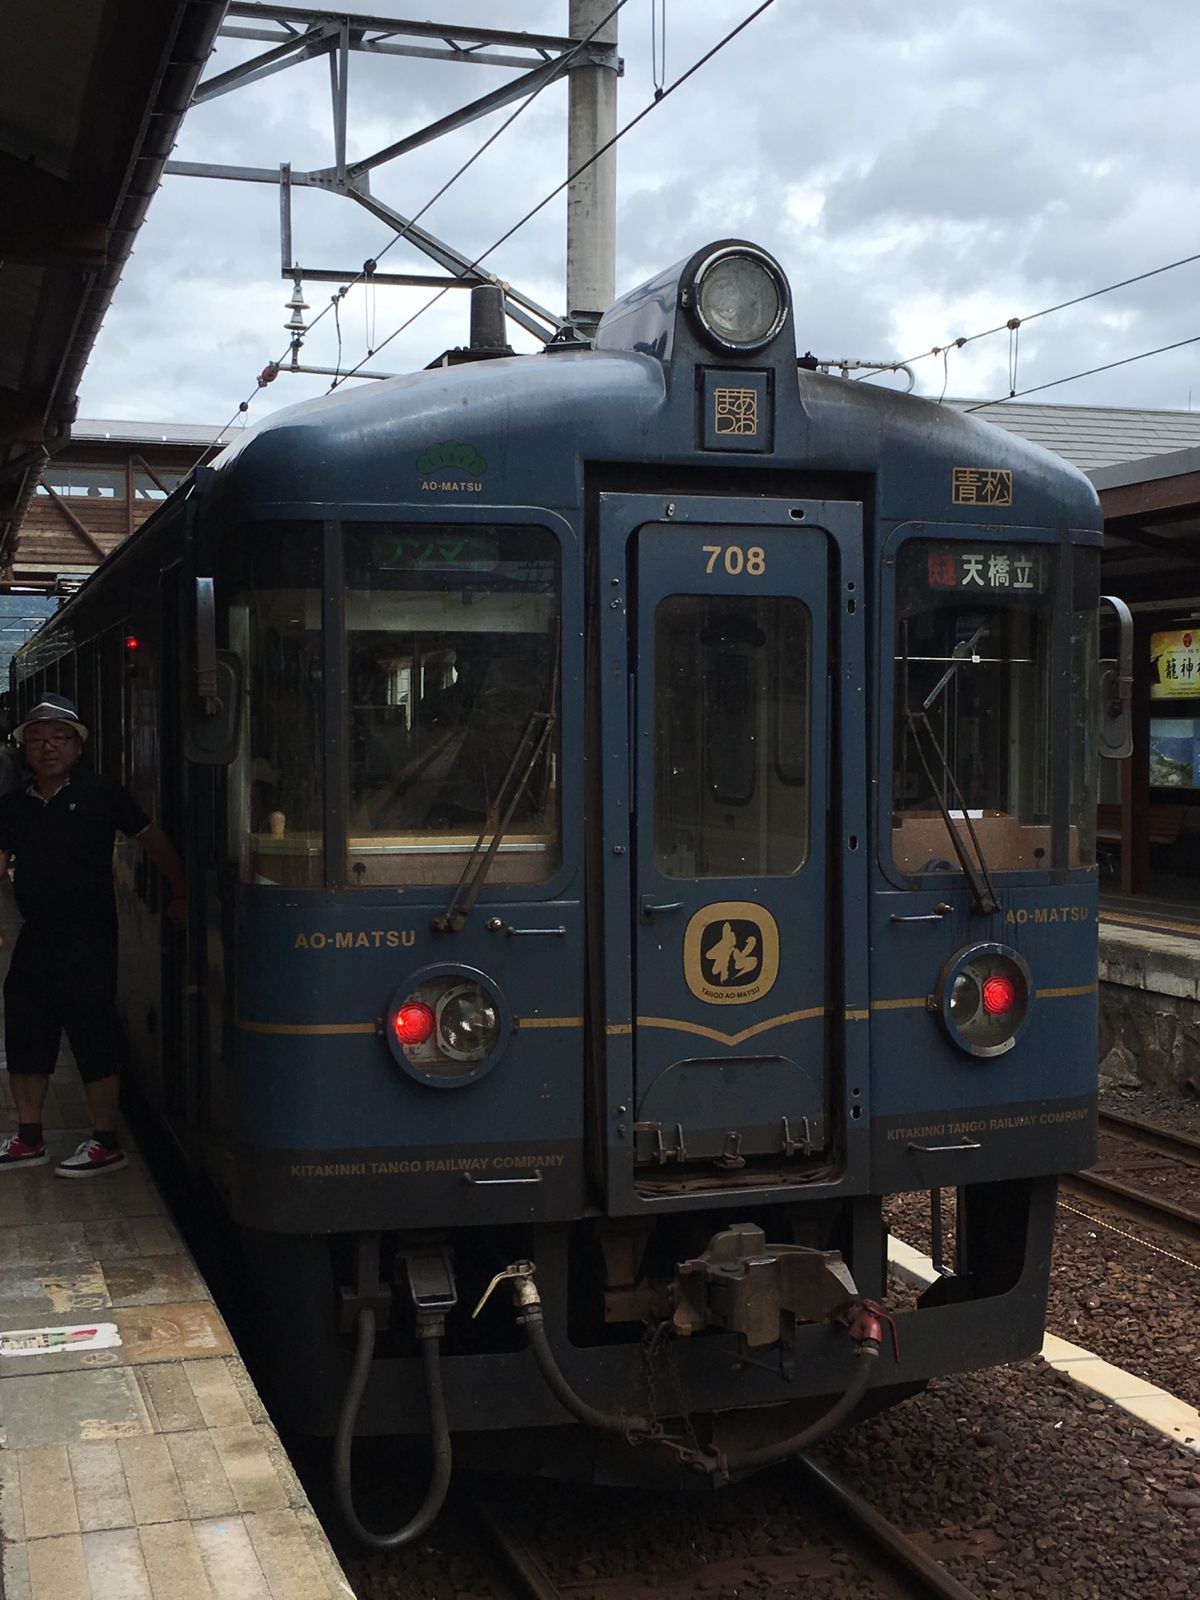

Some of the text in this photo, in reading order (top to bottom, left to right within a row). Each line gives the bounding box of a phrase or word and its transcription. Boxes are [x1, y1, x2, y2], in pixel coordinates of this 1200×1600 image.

[952, 467, 1012, 506] 青松
[702, 544, 766, 576] 708
[961, 554, 1034, 589] 天橋立
[1004, 907, 1089, 925] AO-MATSU
[293, 928, 416, 949] AO-MATSU
[701, 985, 760, 999] TANGO AO-MATSU
[887, 1108, 1089, 1141] KITAKINKI TANGO RAILWAY COMPANY
[290, 1153, 565, 1177] KITAKINKI TANGO RAILWAY COMPANY
